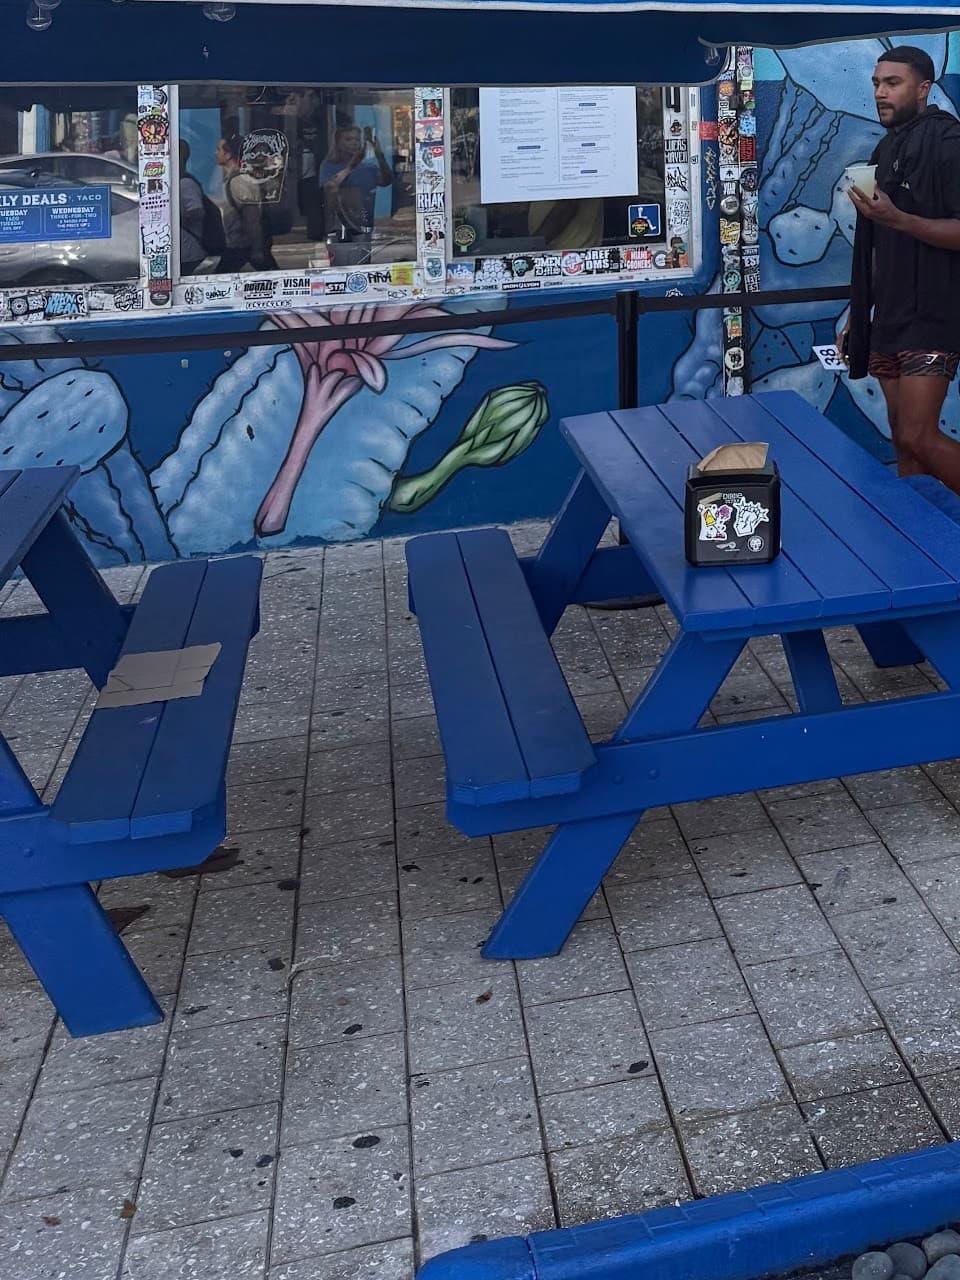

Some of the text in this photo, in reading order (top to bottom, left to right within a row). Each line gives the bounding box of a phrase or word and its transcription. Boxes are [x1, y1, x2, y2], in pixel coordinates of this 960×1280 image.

[22, 193, 68, 206] DEALS
[283, 278, 310, 287] VISAH
[820, 349, 840, 365] 38
